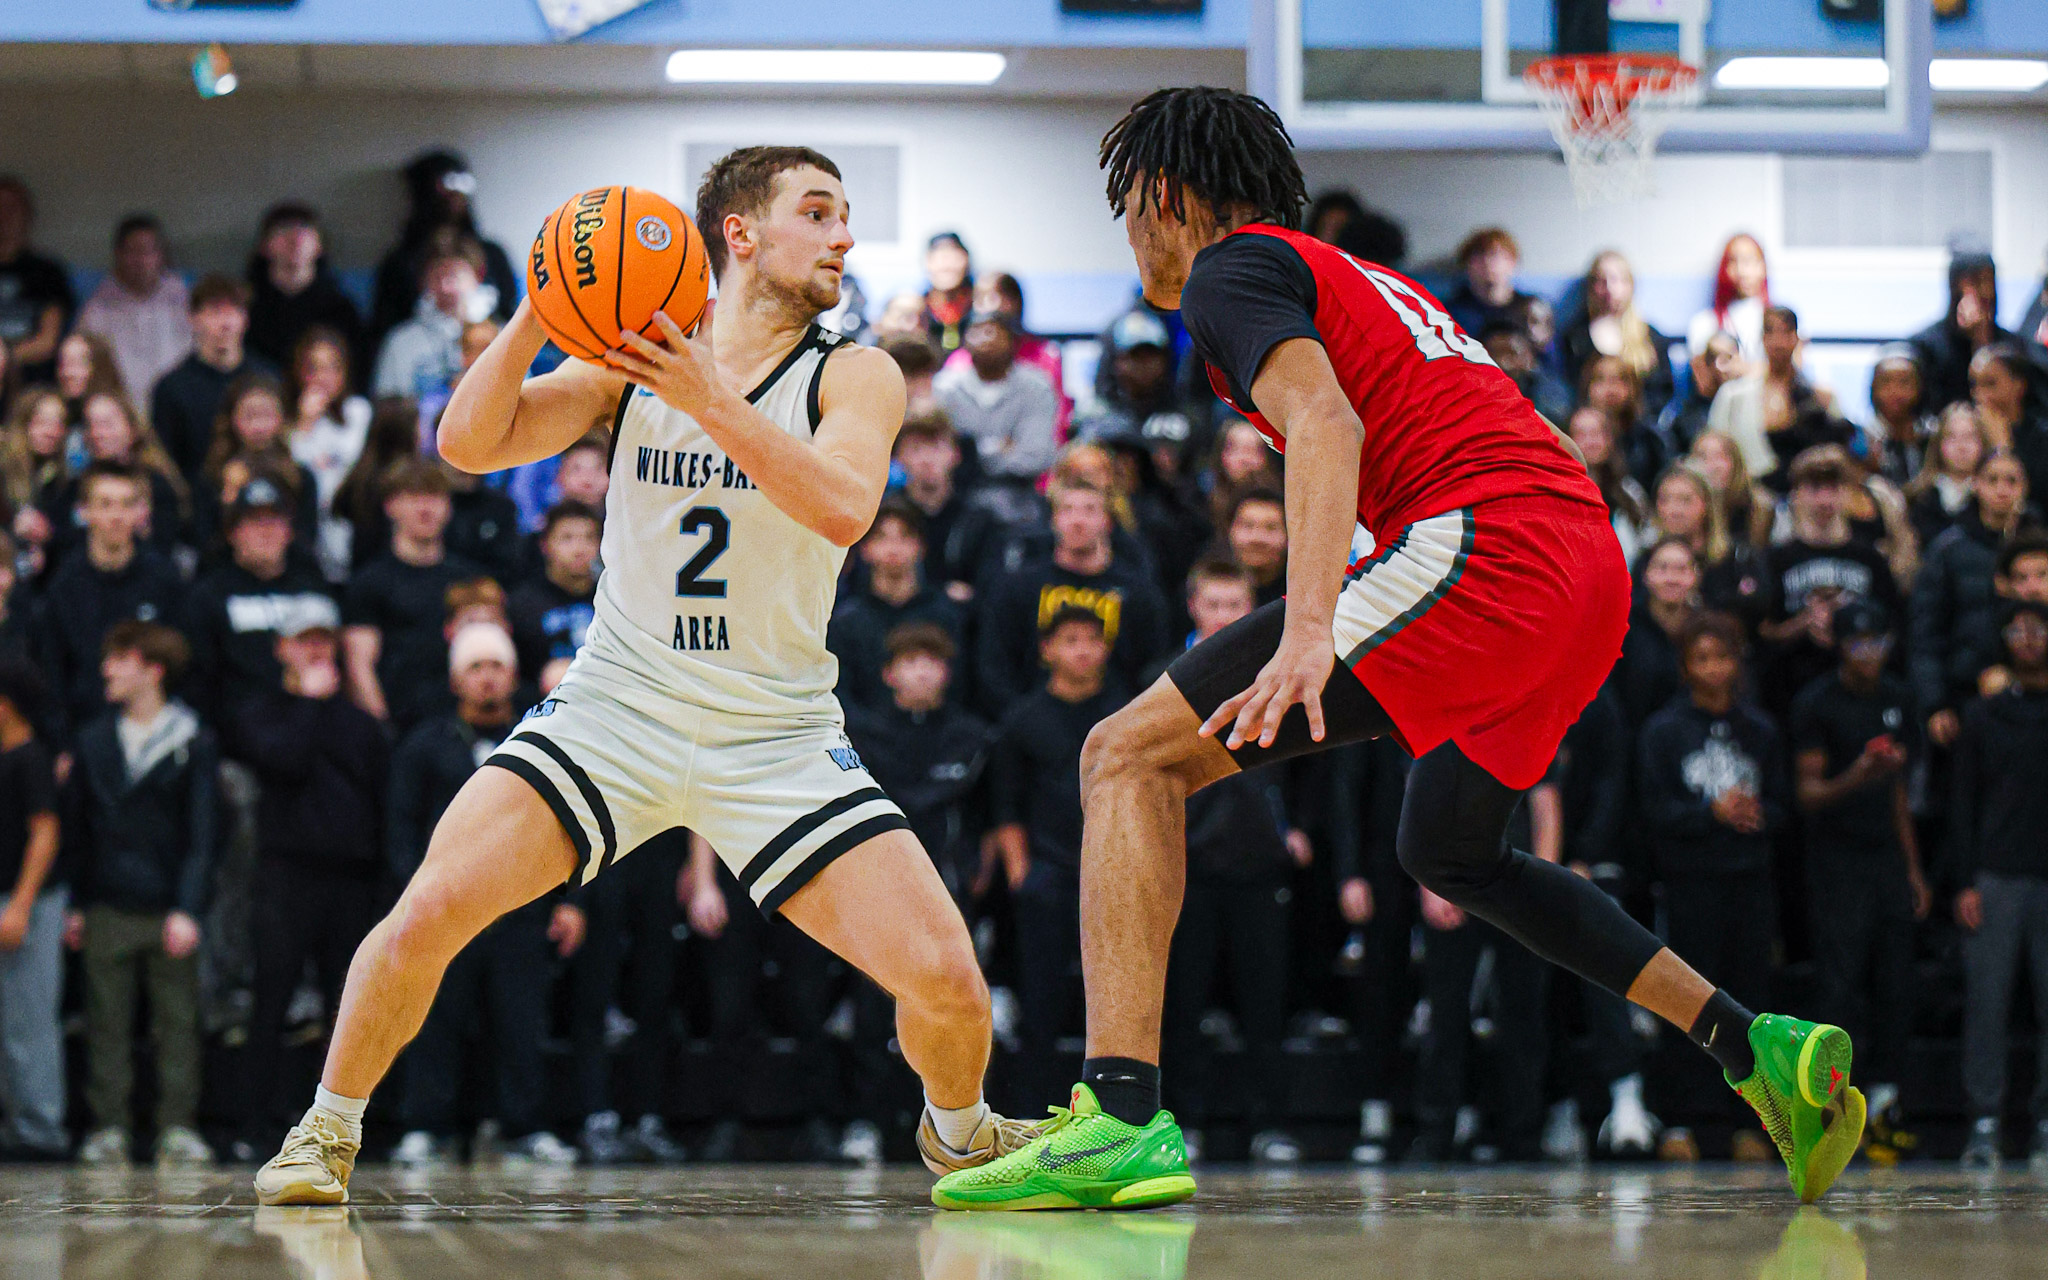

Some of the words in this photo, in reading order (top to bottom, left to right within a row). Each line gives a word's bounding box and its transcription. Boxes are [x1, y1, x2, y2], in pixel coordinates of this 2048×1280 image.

[573, 187, 611, 289] Wilson
[636, 446, 758, 489] WILKES-BA
[675, 506, 731, 598] 2
[672, 615, 730, 650] AREA
